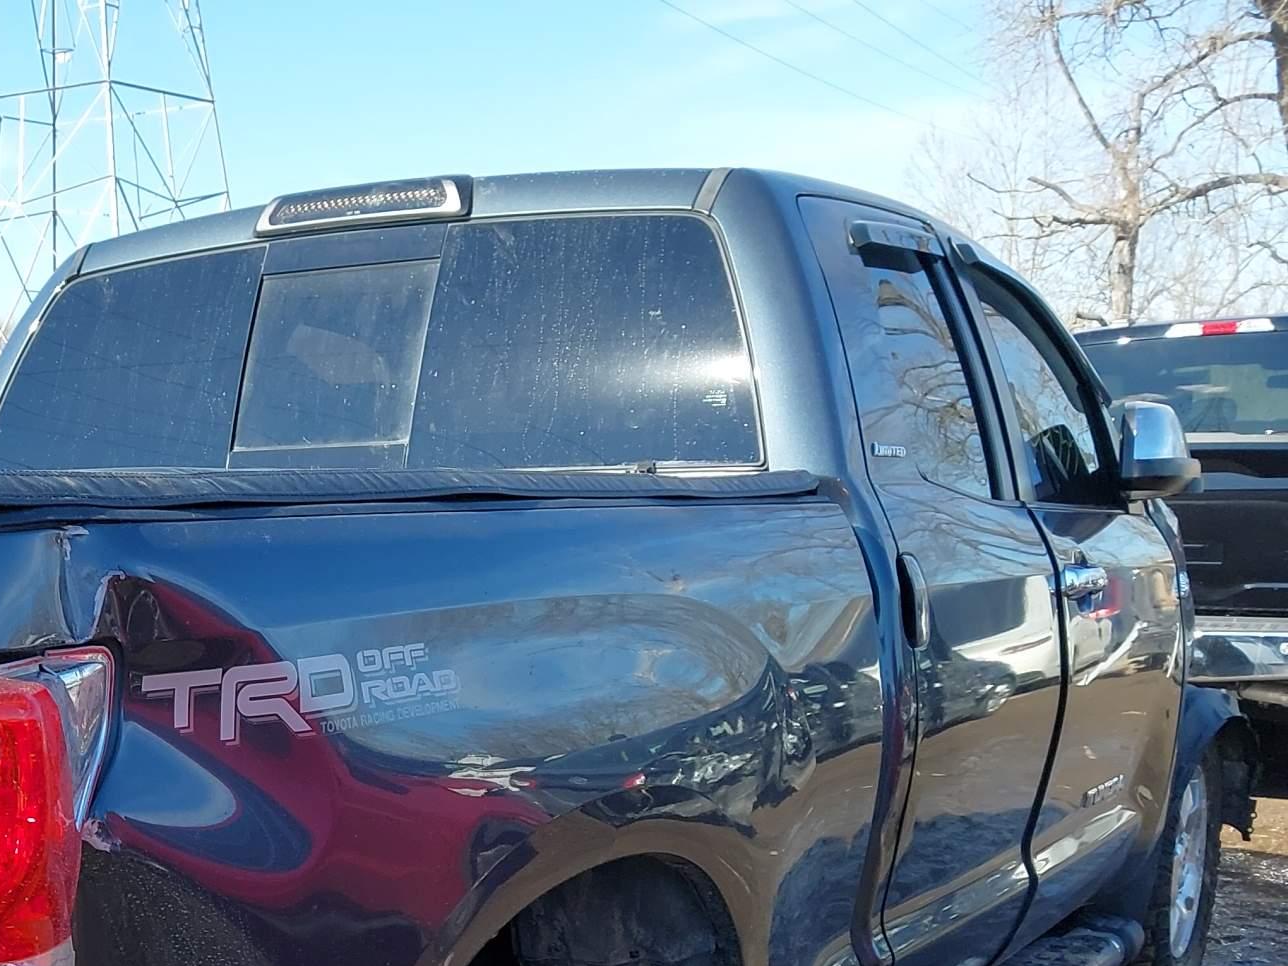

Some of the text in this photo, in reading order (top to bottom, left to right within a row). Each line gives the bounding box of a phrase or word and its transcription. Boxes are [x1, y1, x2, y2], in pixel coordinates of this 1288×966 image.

[357, 642, 429, 674] OFF
[140, 653, 356, 744] TRD
[361, 669, 461, 708] ROAD
[319, 717, 360, 735] TOYOTA
